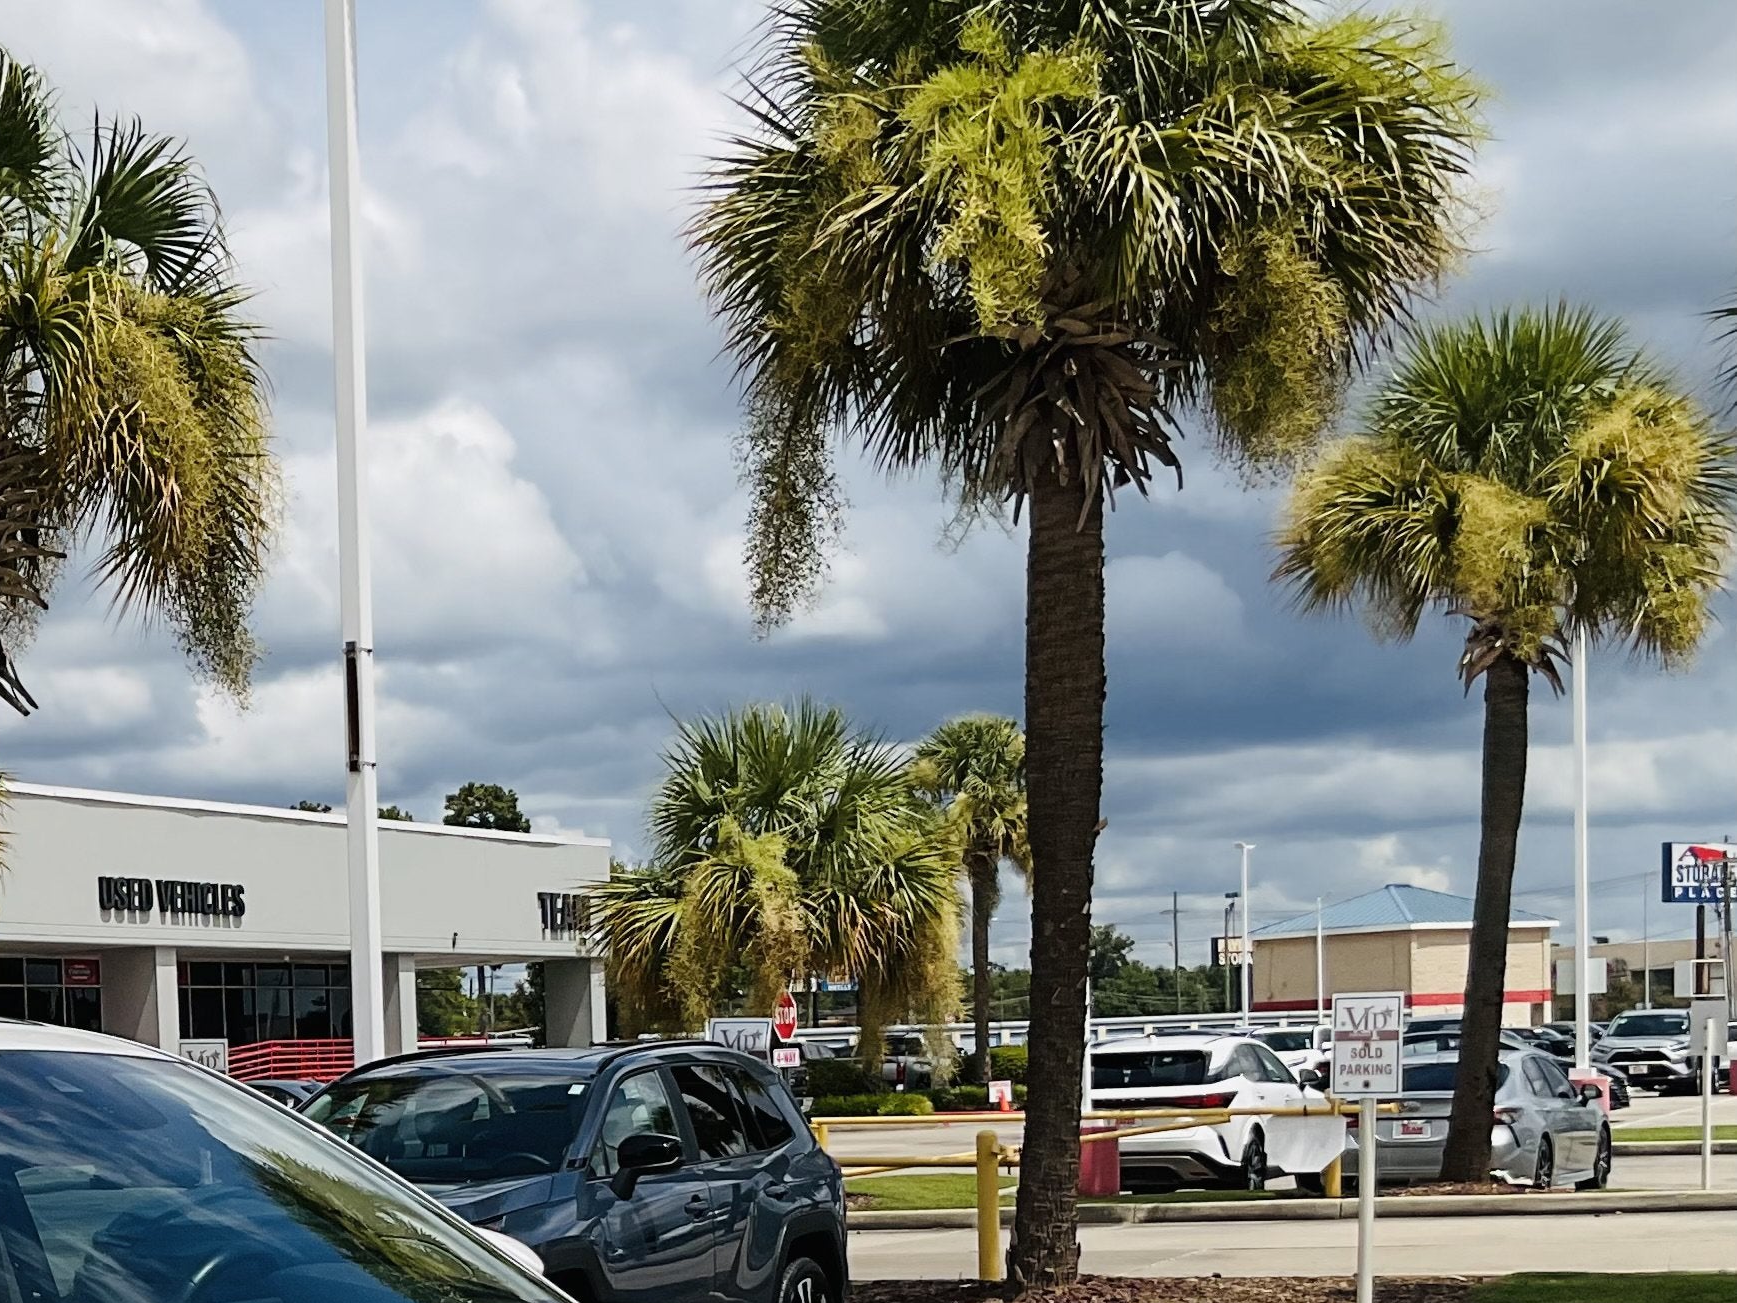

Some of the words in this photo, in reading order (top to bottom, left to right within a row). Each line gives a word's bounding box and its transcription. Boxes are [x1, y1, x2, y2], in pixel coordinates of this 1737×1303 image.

[98, 876, 153, 911] USED
[155, 879, 245, 917] VEHICLES
[774, 1006, 795, 1025] STOP
[776, 1052, 796, 1063] 4-WAY
[1350, 1047, 1383, 1059] SOLD
[1339, 1064, 1393, 1075] PARKING
